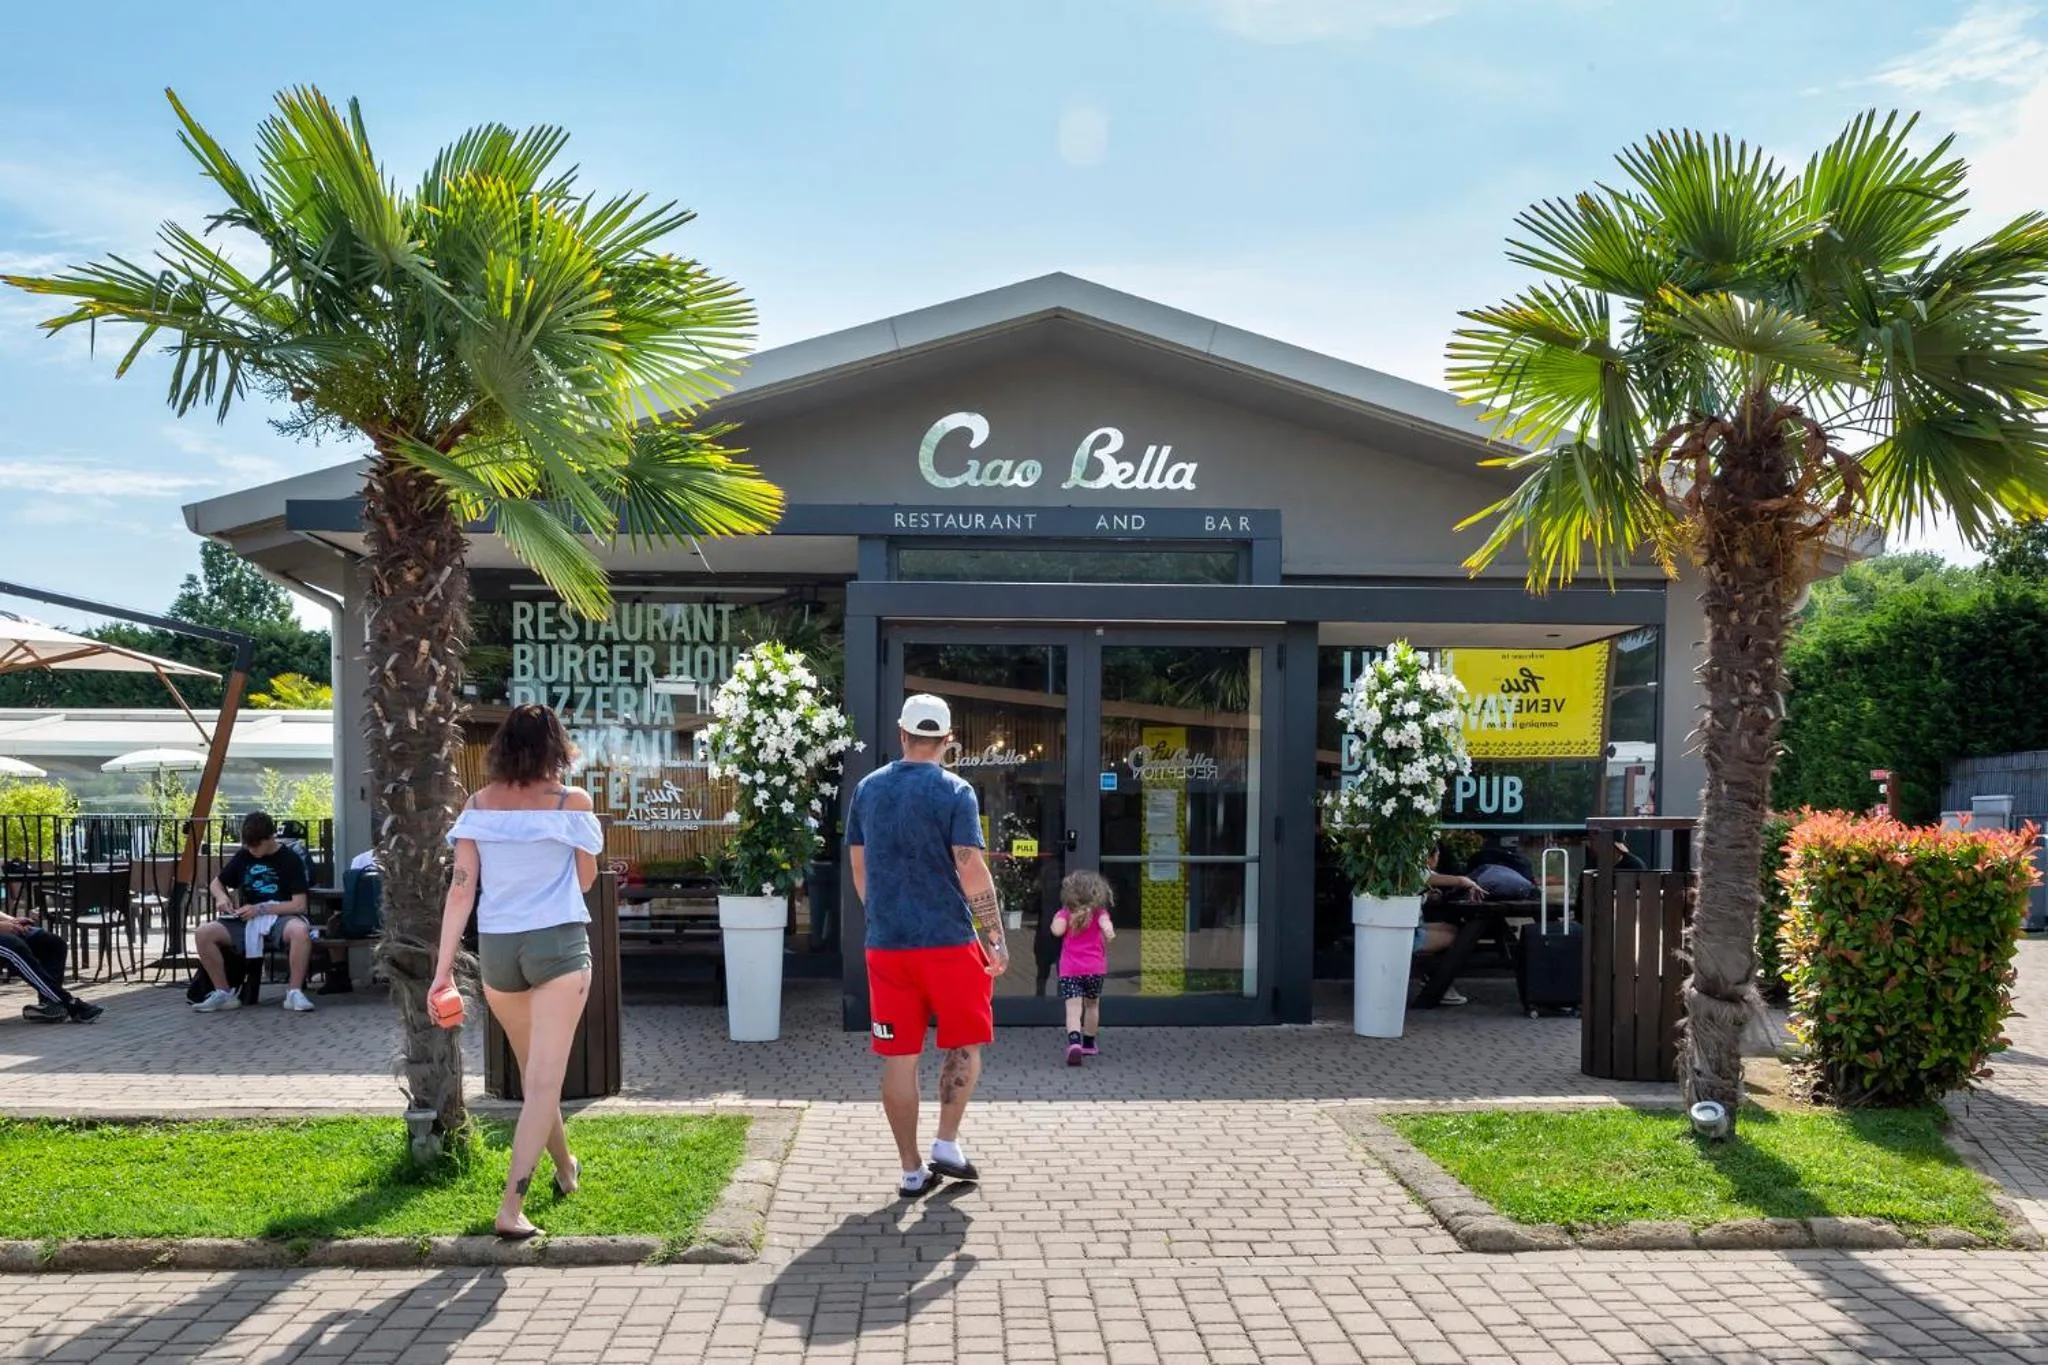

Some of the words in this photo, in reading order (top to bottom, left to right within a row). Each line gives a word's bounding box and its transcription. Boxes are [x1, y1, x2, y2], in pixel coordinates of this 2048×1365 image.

[918, 411, 1043, 489] Ciao
[1061, 426, 1199, 491] Bella
[894, 512, 1038, 530] RESTAURANT
[1095, 514, 1146, 531] AND
[1204, 515, 1251, 532] BAR
[512, 601, 736, 641] RESTAURANT
[512, 643, 656, 684] BURGER
[669, 645, 741, 685] HOU
[1455, 775, 1524, 815] PUB
